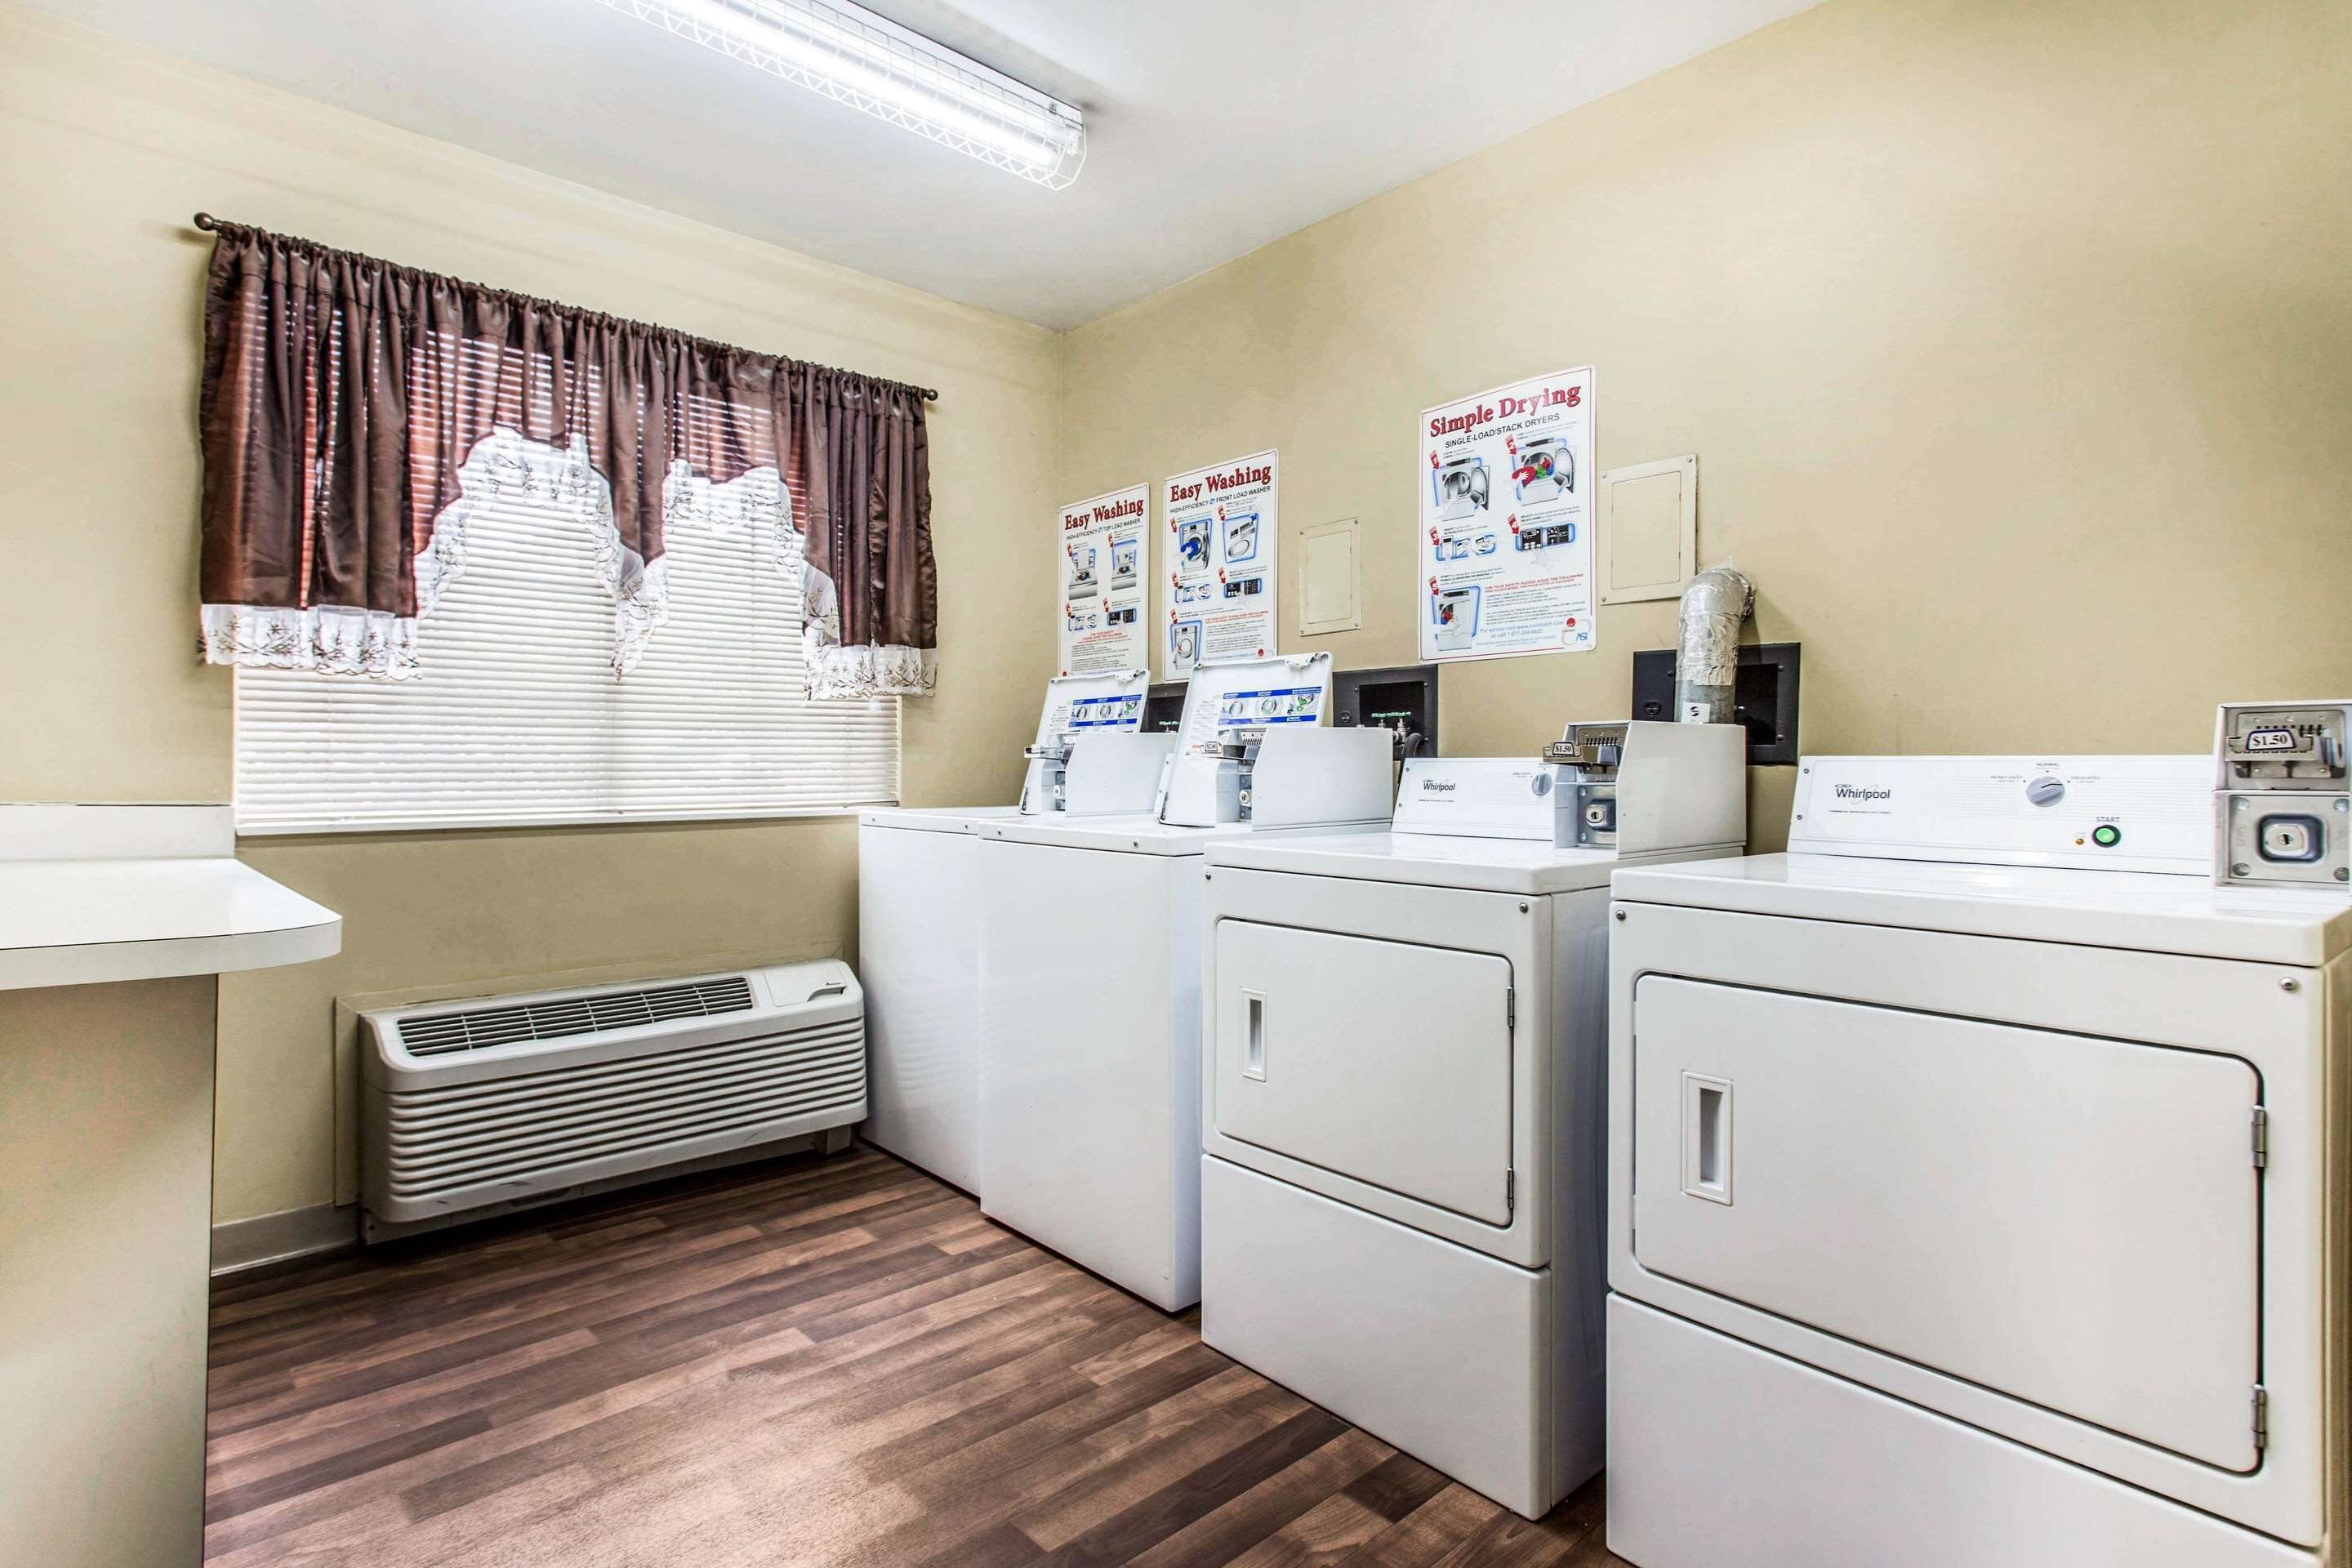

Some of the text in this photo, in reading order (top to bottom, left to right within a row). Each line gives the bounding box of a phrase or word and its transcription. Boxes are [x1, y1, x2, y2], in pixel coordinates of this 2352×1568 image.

[1430, 404, 1494, 438] Simple
[1499, 385, 1581, 416] Drying
[1445, 423, 1523, 448] SINGLE-LOAD/STACK
[1525, 413, 1560, 428] DRYERS
[1170, 466, 1271, 502] Easy Washing
[1169, 501, 1209, 514] HIGH-EFFICIENCY
[1233, 491, 1248, 499] LOAD
[1248, 485, 1271, 496] WASHER
[1065, 500, 1143, 530] Easy Washing
[1123, 518, 1141, 527] WASHER
[2253, 734, 2287, 746] $1.50
[1423, 782, 1455, 792] Whirlpool
[1836, 788, 1891, 801] Whirlpool
